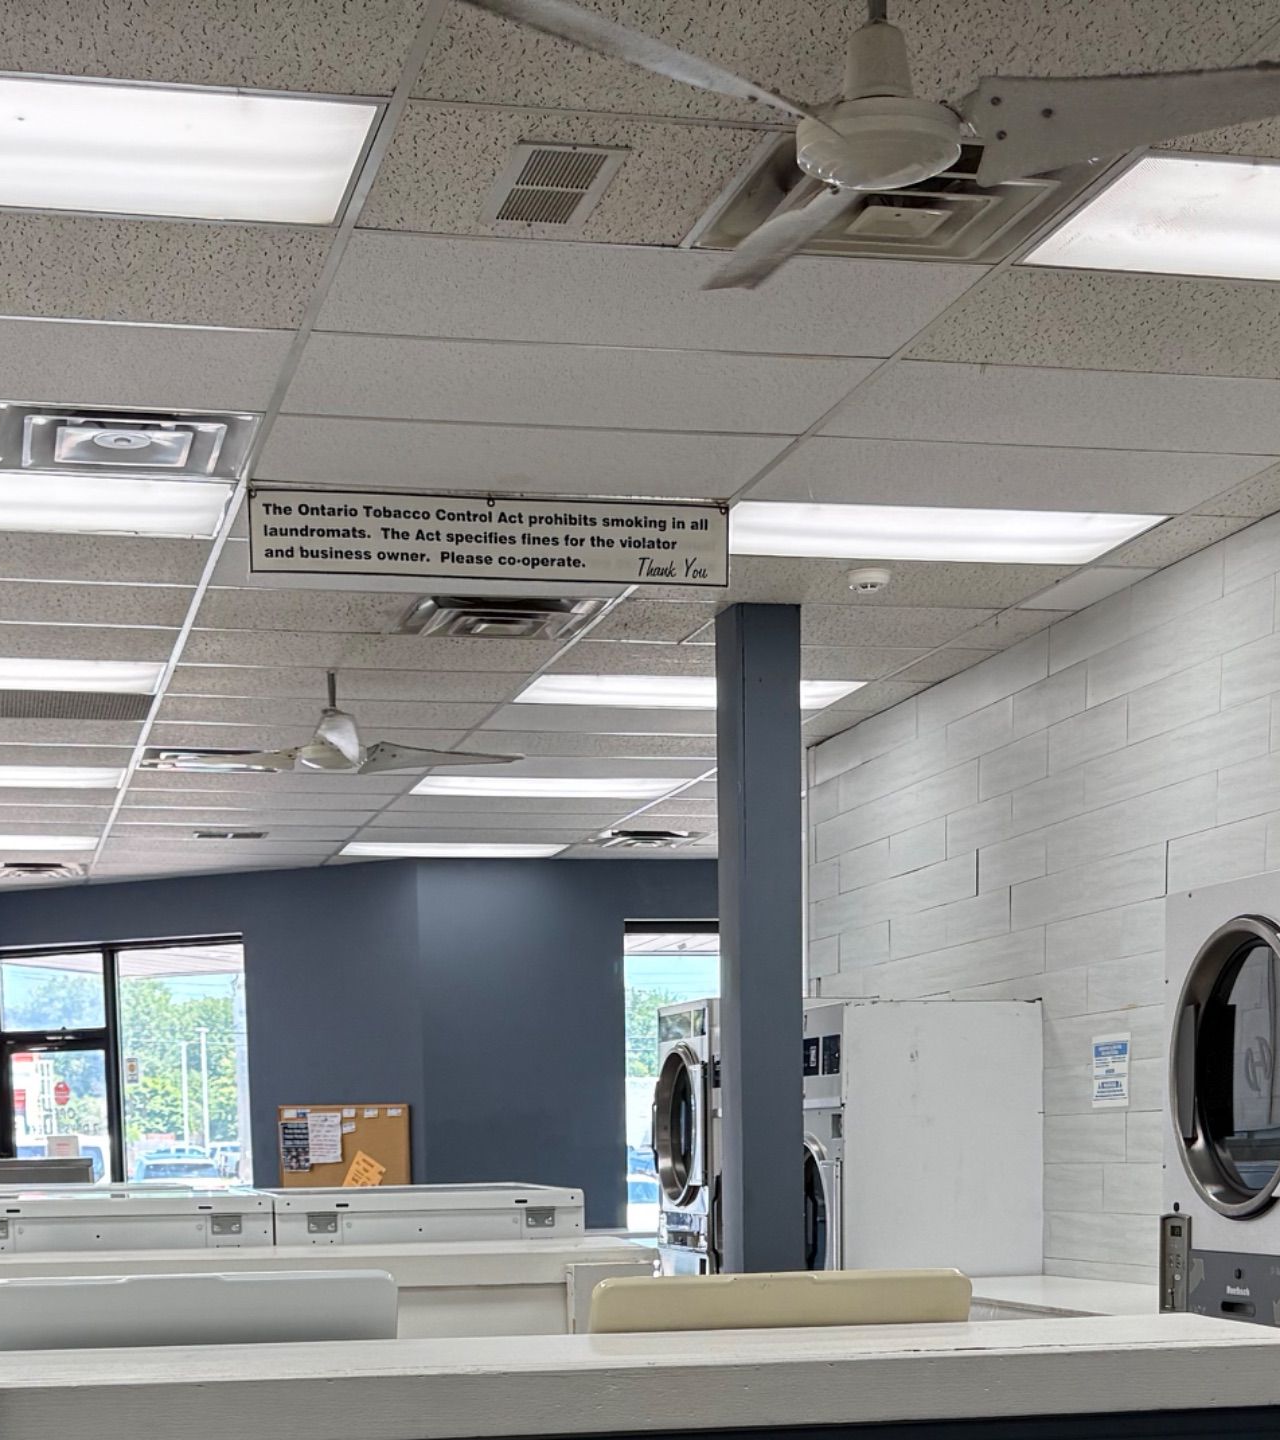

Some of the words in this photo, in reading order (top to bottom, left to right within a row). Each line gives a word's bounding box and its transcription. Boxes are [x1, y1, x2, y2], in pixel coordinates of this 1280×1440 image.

[262, 503, 292, 516] The
[298, 503, 358, 518] Ontario
[363, 505, 431, 520] Tobacco
[436, 508, 493, 523] Control
[498, 512, 523, 525] Act
[528, 513, 597, 528] prohibits
[602, 516, 666, 531] smoking
[672, 517, 685, 530] in
[690, 518, 708, 531] all
[264, 524, 371, 539] laundromats.
[381, 527, 410, 540] The
[415, 529, 441, 542] Act
[446, 530, 516, 546] specifies
[521, 533, 559, 547] fines
[564, 534, 585, 547] for
[590, 535, 615, 548] the
[619, 536, 677, 550] violator
[265, 546, 294, 559] and
[299, 546, 372, 561] business
[377, 551, 430, 563] owner.
[440, 551, 493, 565] Please
[638, 556, 676, 578] Thank
[683, 556, 708, 579] You
